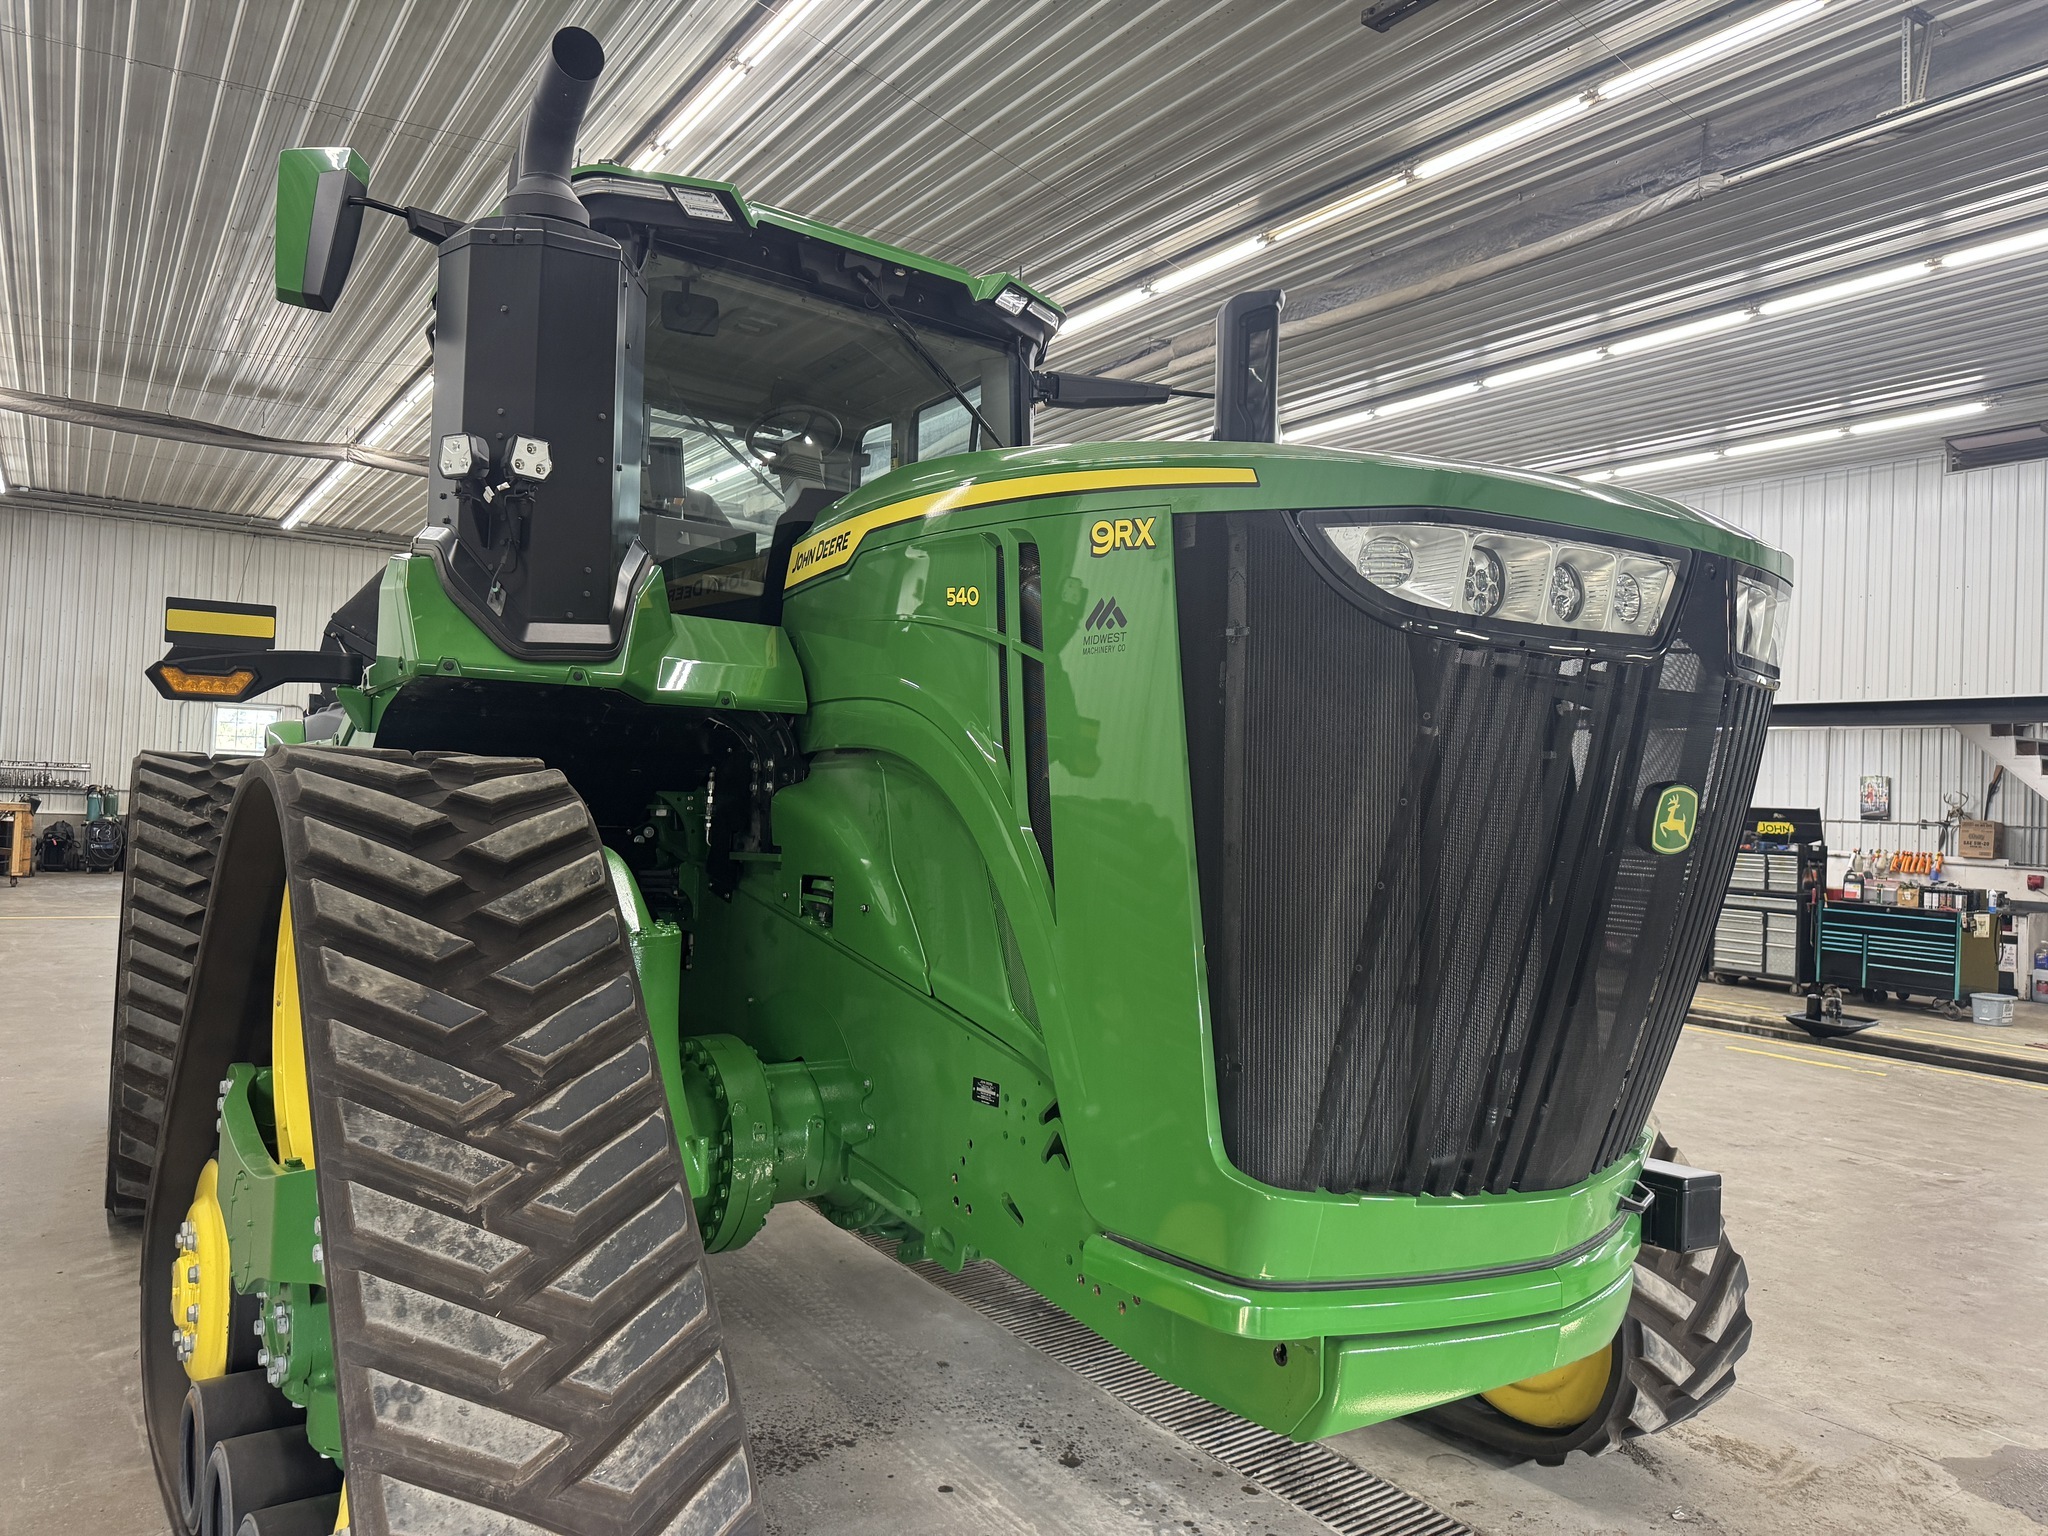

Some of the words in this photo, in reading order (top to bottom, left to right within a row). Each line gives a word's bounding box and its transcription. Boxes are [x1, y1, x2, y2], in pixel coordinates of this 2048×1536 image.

[1089, 516, 1157, 558] 9RX
[791, 546, 816, 574] JOHN
[815, 530, 852, 562] DEERE
[946, 586, 980, 607] 540
[1083, 631, 1127, 646] MIDWEST
[1082, 645, 1116, 655] MACHINERY
[1117, 643, 1126, 652] CO
[1760, 823, 1790, 833] JOHN
